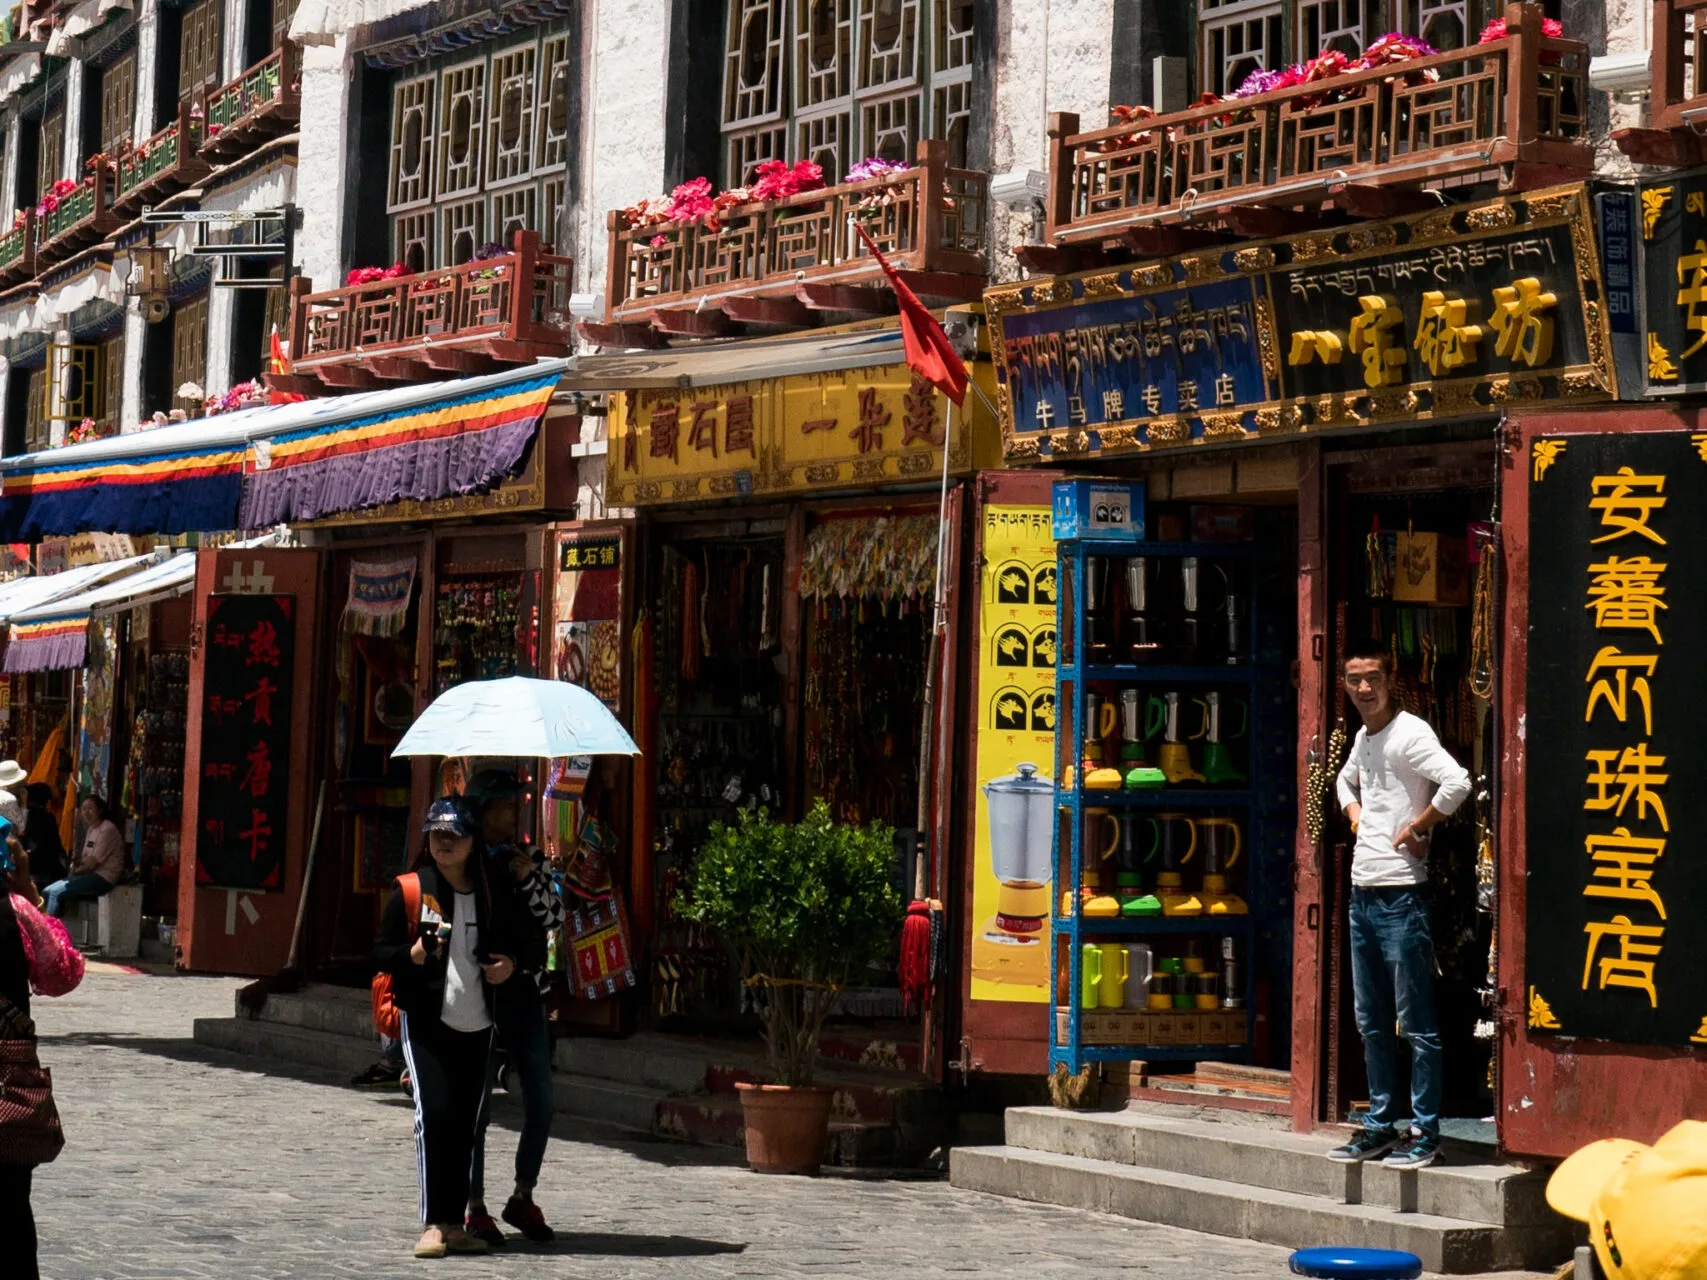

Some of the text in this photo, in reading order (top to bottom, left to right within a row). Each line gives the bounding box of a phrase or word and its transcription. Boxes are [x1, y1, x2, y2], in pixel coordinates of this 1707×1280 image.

[1036, 374, 1236, 427] 牛马牌专卖店
